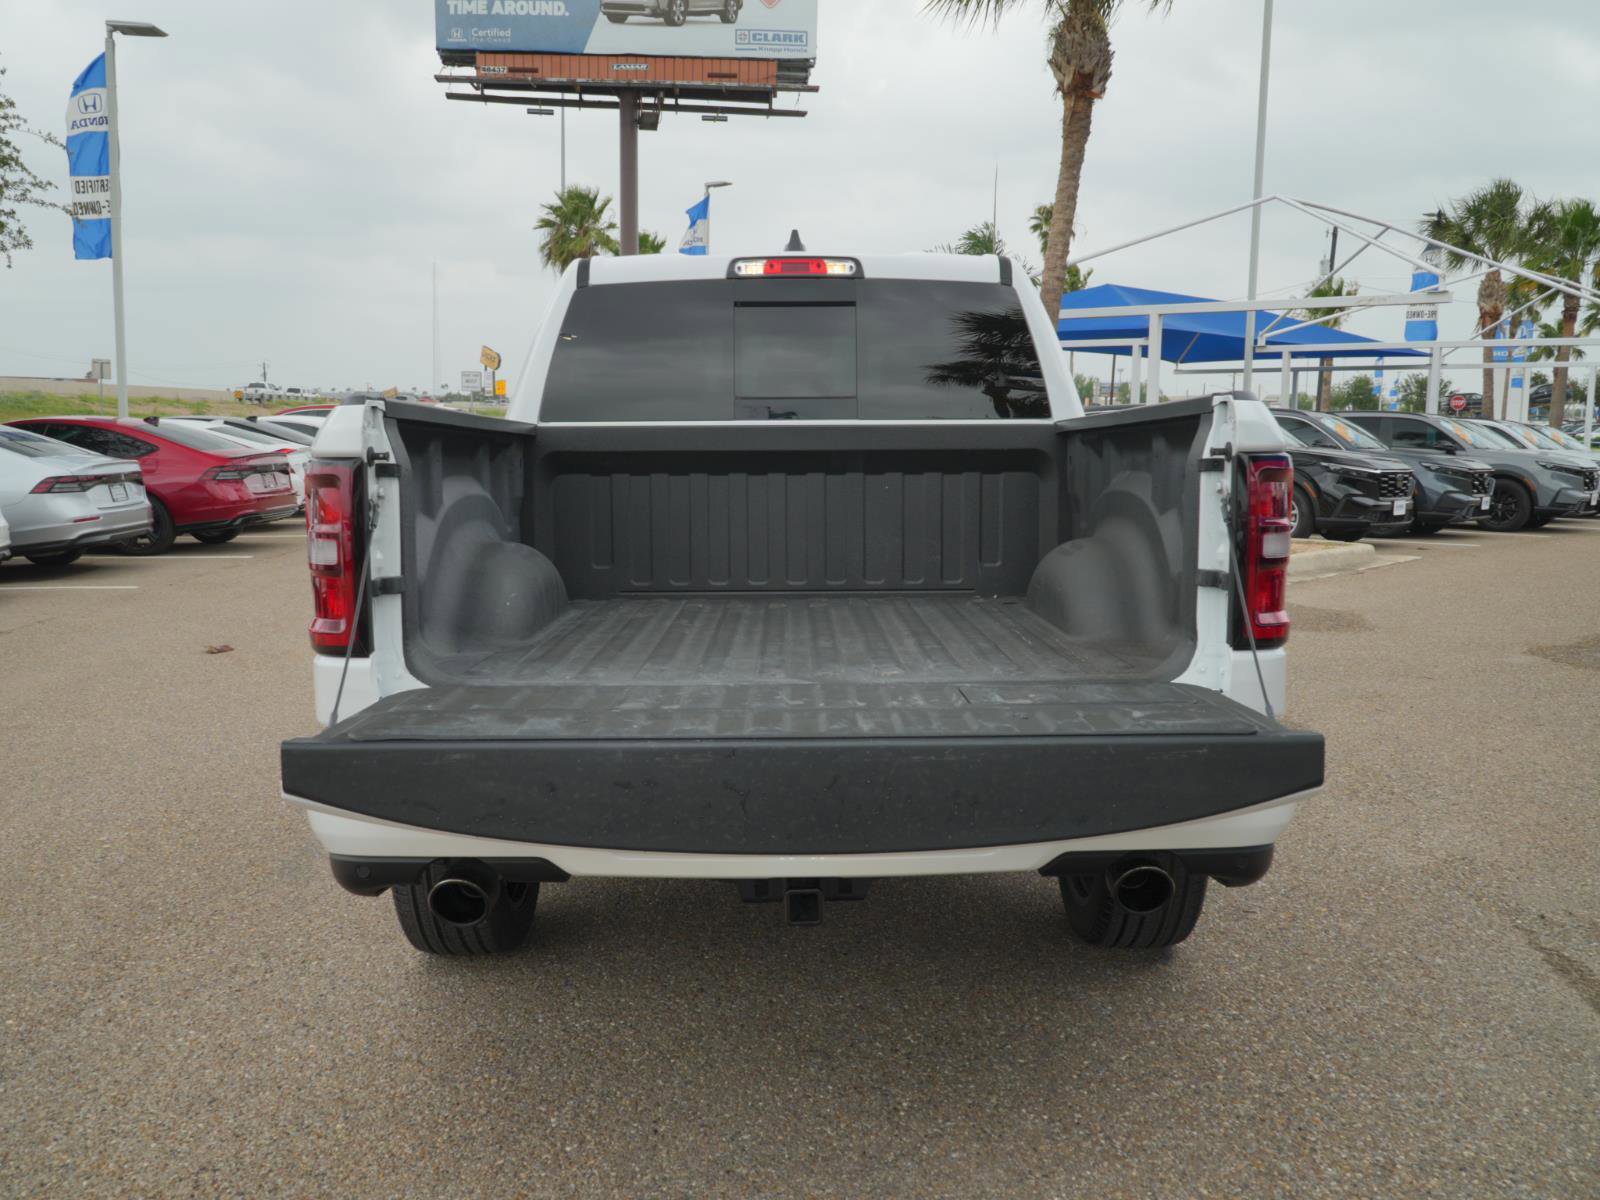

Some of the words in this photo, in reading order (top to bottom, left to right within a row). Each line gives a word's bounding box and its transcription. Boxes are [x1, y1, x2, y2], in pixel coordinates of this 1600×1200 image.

[447, 0, 488, 15] TIME
[491, 0, 570, 16] AROUND.
[471, 27, 512, 37] Certified
[752, 32, 805, 43] CLARK
